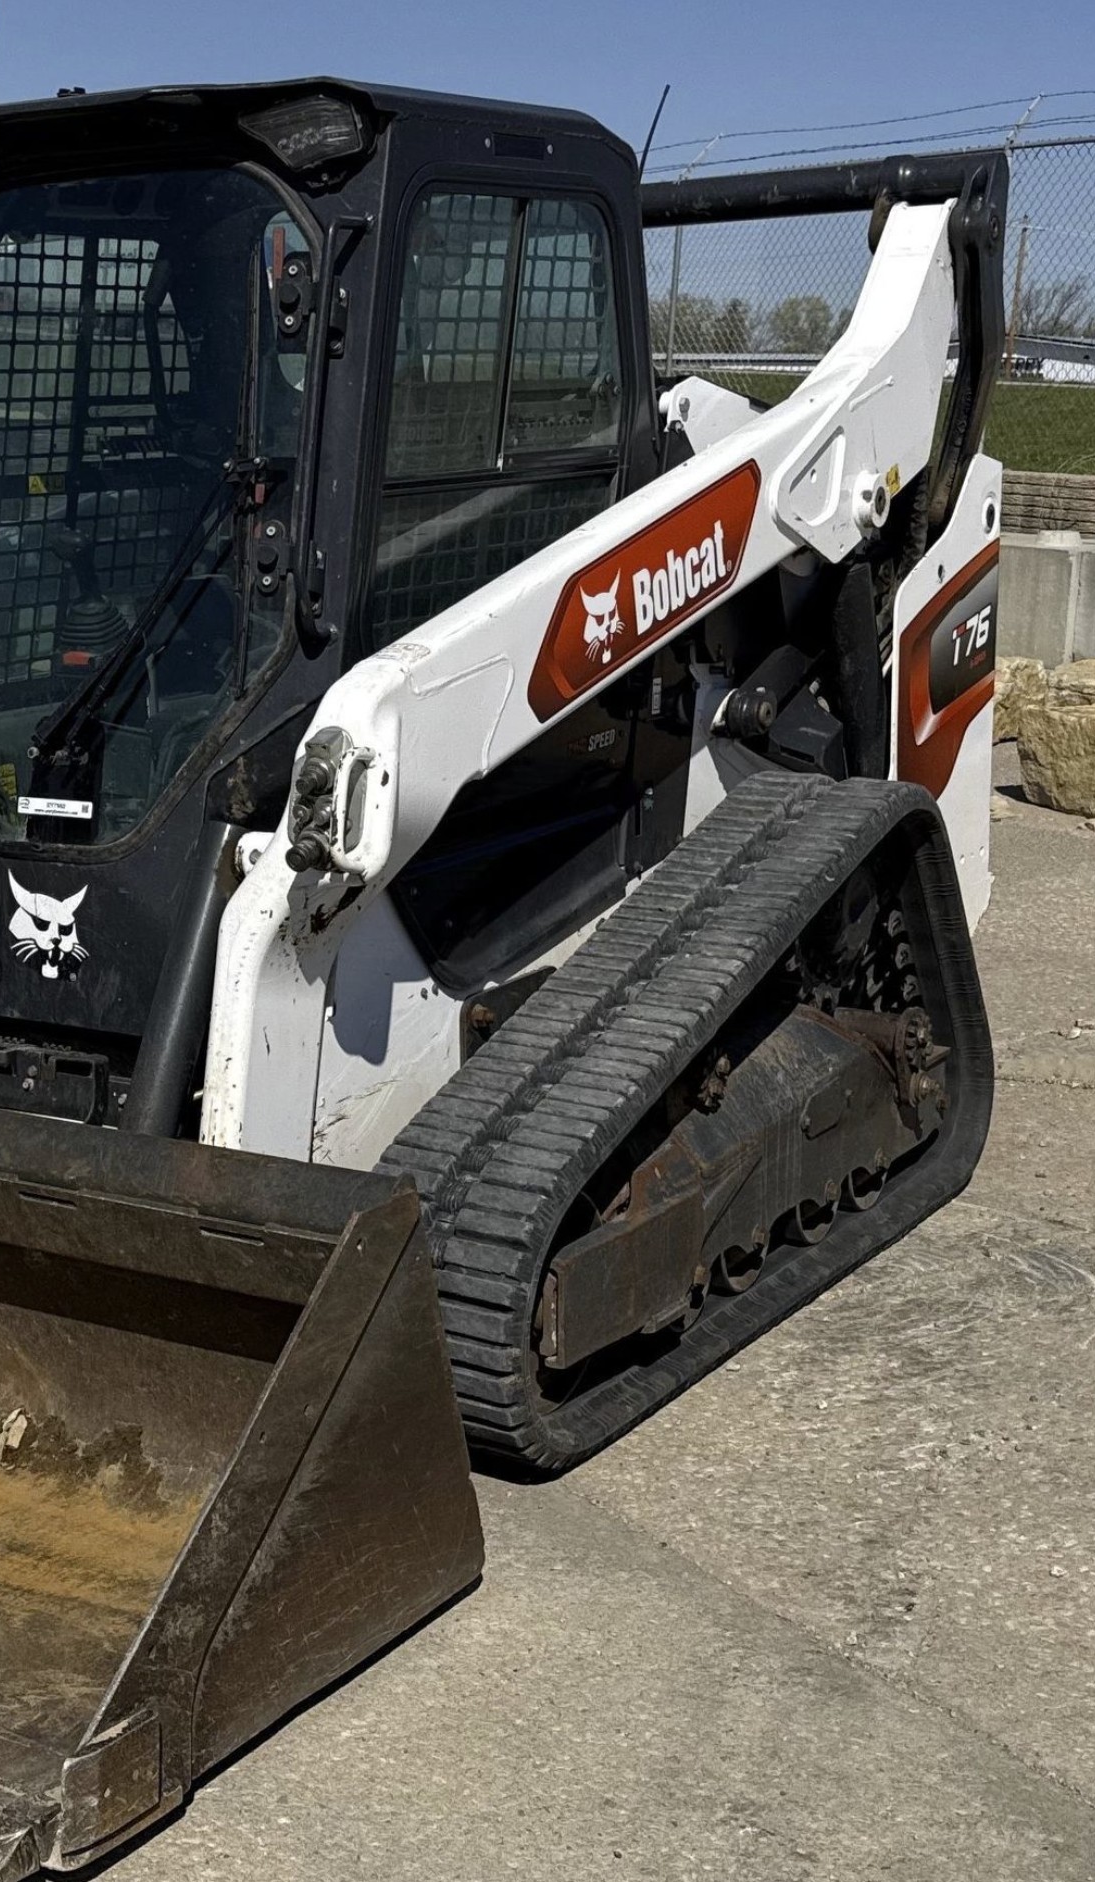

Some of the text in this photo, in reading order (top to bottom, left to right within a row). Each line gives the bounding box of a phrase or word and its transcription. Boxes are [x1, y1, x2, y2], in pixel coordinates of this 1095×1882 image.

[632, 519, 727, 636] Bobcat
[952, 604, 992, 667] T76
[588, 729, 615, 752] SPEED
